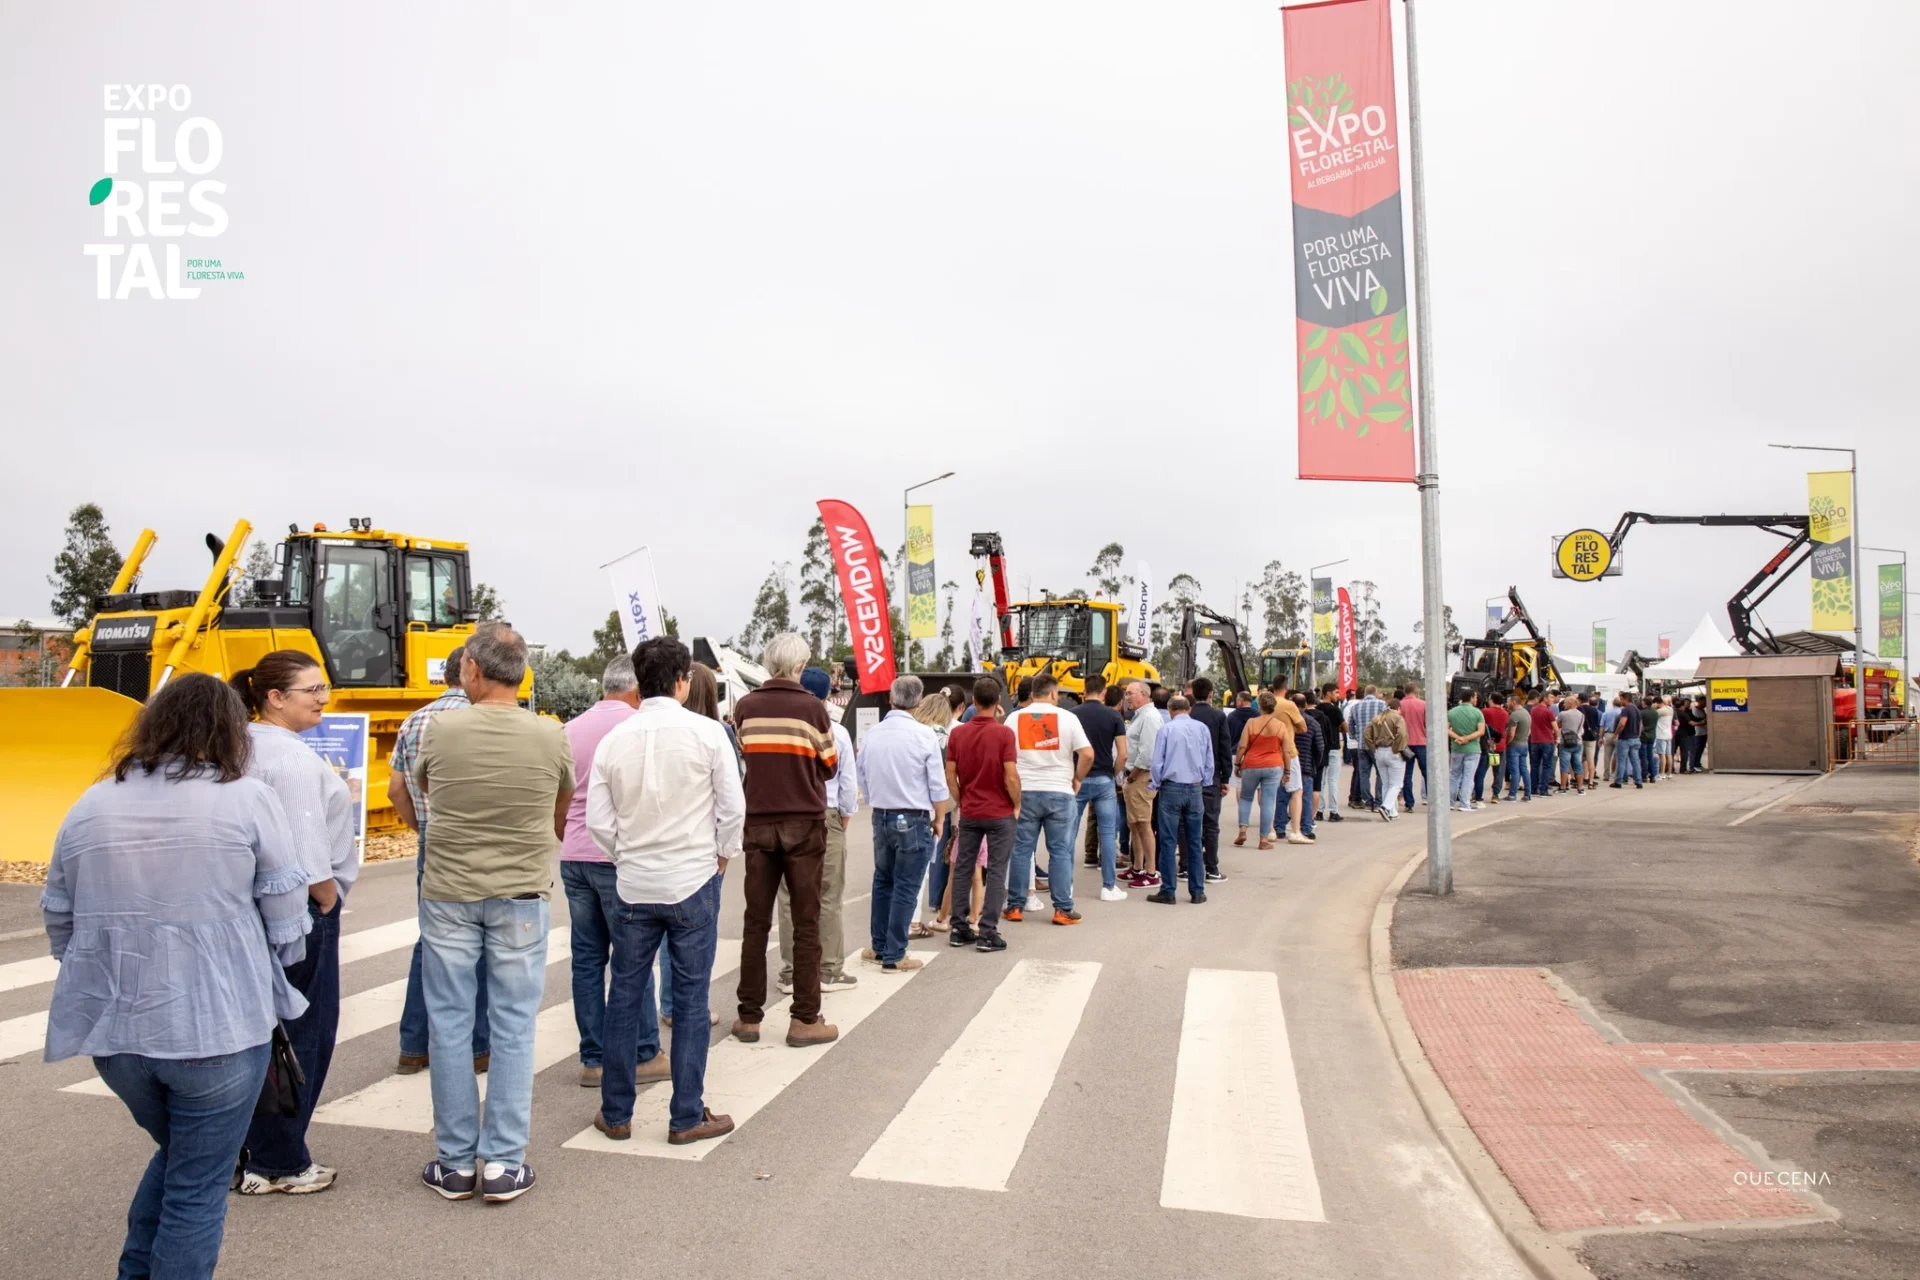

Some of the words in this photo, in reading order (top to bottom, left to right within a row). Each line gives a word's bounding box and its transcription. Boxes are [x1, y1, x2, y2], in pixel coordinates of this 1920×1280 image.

[1292, 104, 1387, 159] EXPO
[1299, 135, 1395, 177] FLORESTAL
[1307, 155, 1387, 189] ALBERGARIA-A-VELHA
[1303, 234, 1339, 260] POR
[1340, 225, 1379, 249] UMA
[1307, 242, 1392, 280] FLORESTA
[1313, 268, 1382, 310] VIVA
[1811, 505, 1847, 524] EXPO
[910, 532, 932, 549] EXPO
[1575, 541, 1598, 551] FLO
[1575, 552, 1599, 563] RES
[1814, 549, 1827, 558] POR
[1827, 546, 1842, 555] UMA
[1815, 552, 1847, 564] FLORESTA
[1571, 564, 1594, 574] TAL
[1817, 561, 1843, 575] VIVA
[913, 580, 932, 591] VIVA
[96, 623, 150, 640] KOMATSU
